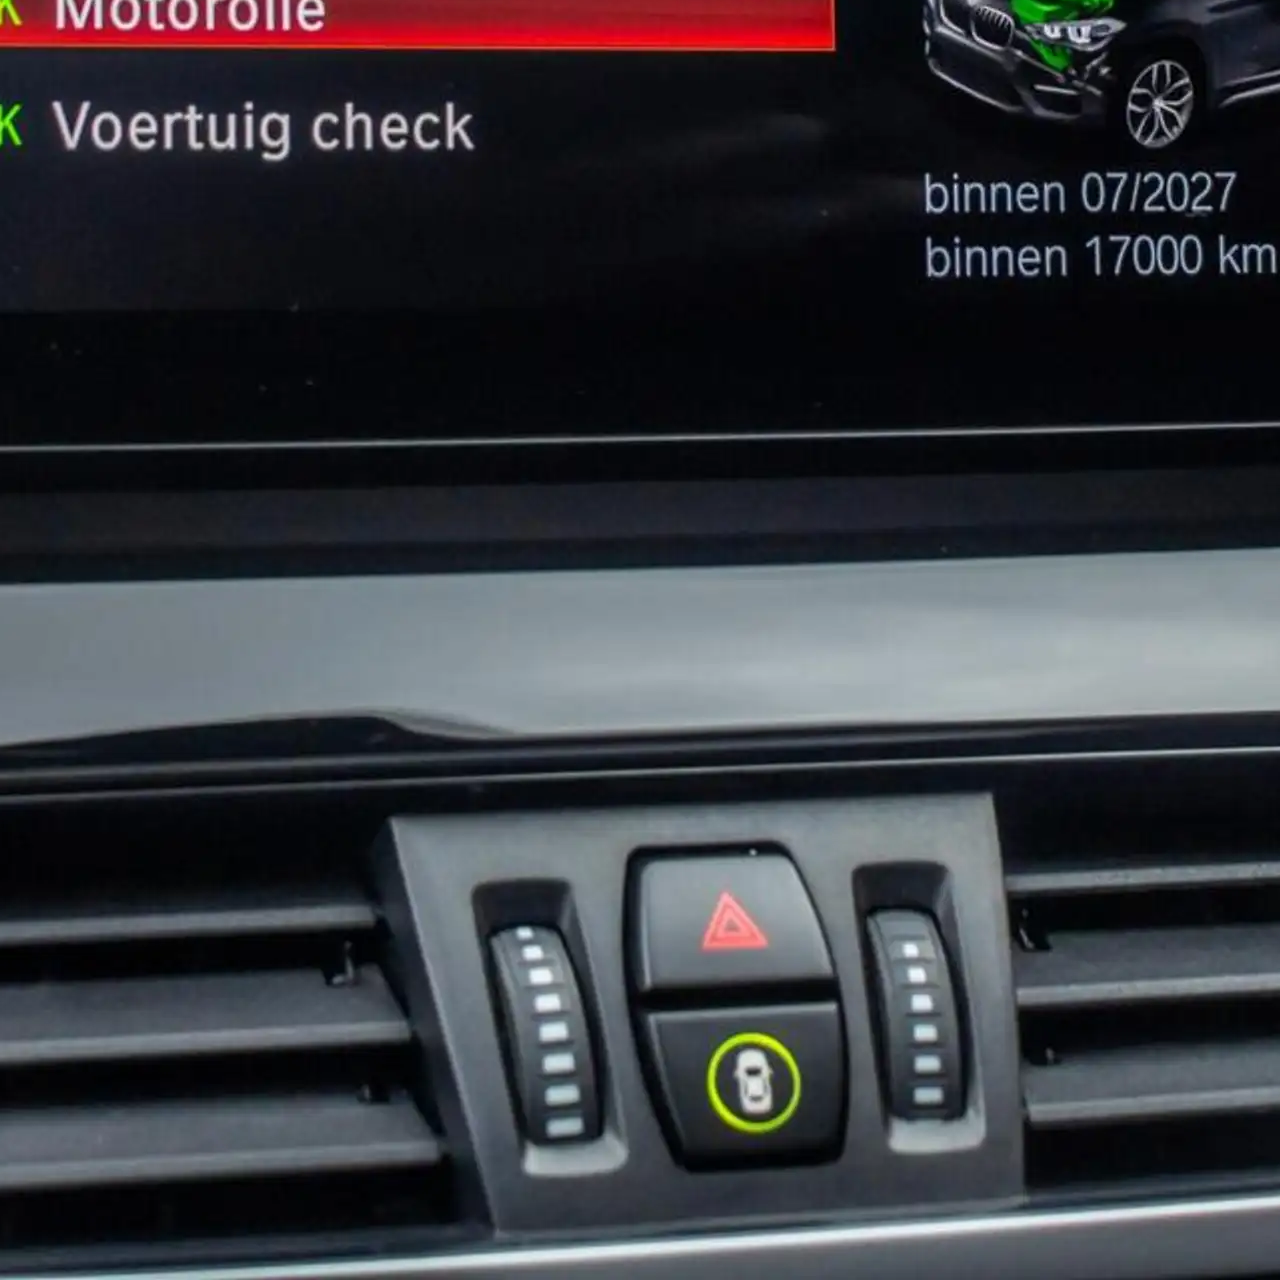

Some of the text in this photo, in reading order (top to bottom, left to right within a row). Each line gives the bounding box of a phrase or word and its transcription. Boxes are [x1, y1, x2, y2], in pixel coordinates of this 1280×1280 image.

[52, 100, 291, 161] Voertuig
[312, 102, 475, 151] check
[924, 171, 1238, 214] binnen 07/2027
[925, 234, 1278, 278] binnen 17000 km
